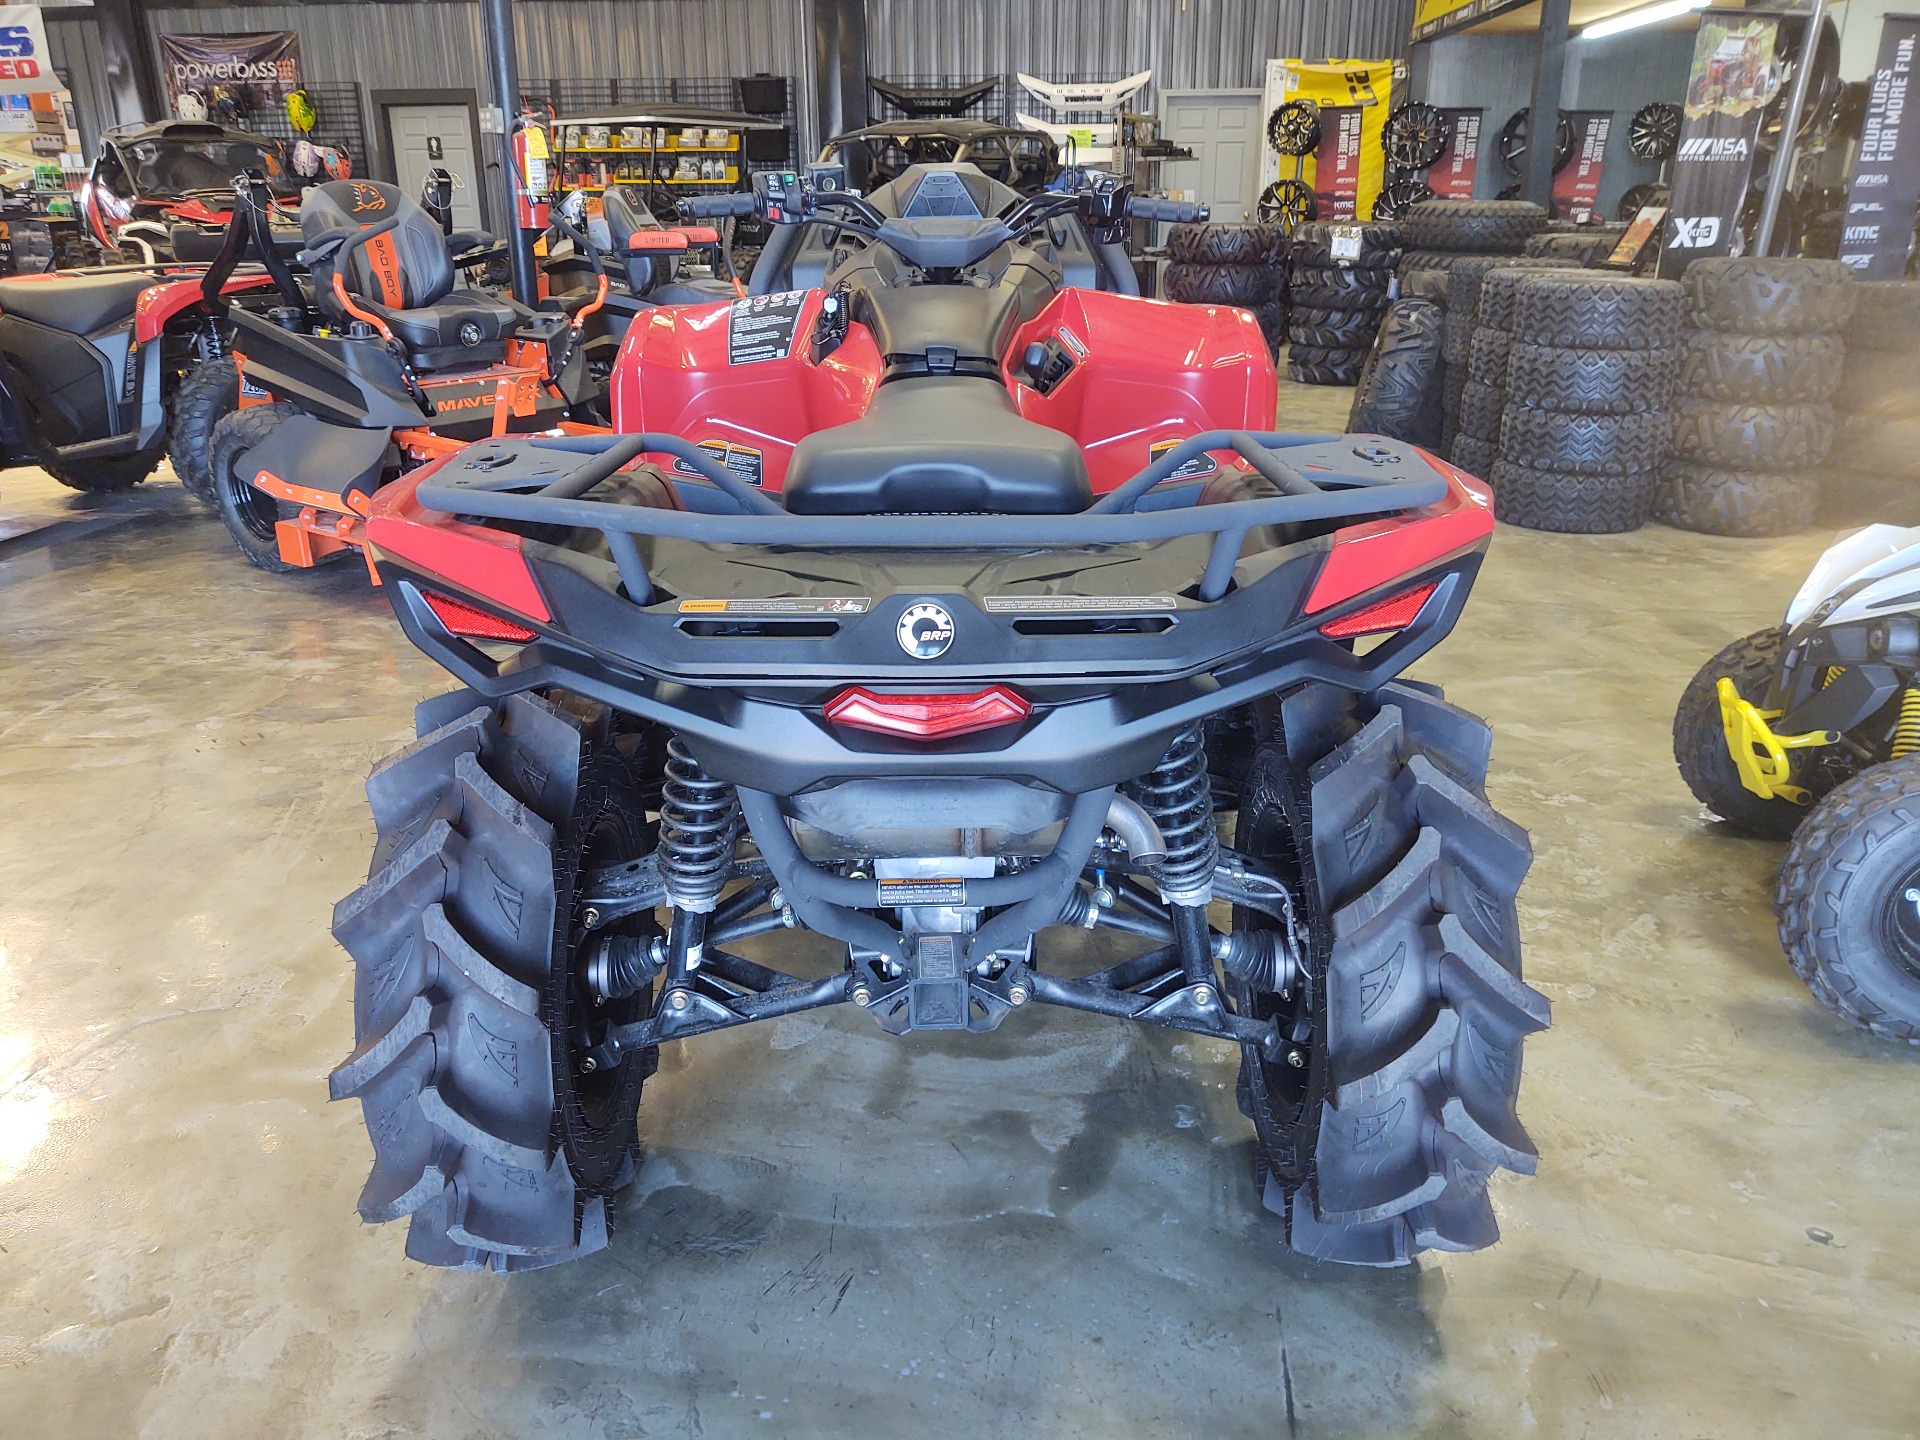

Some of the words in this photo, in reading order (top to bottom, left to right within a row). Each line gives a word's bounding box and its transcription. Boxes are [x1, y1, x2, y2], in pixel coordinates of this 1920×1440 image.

[1894, 33, 1917, 72] FUN.
[174, 56, 278, 86] powerbass
[1869, 69, 1892, 114] LUGS
[1884, 77, 1908, 124] MORE
[1339, 114, 1350, 131] FOR
[1350, 113, 1361, 135] FOUR
[1457, 116, 1469, 133] FOR
[1467, 116, 1480, 138] FOUR
[1587, 118, 1599, 135] FOR
[1596, 118, 1611, 140] FOUR
[1337, 131, 1349, 154] MORE
[1348, 135, 1360, 157] LUGS
[1453, 133, 1466, 156] MORE
[1464, 138, 1478, 160] LUGS
[1582, 136, 1596, 159] MORE
[1711, 138, 1748, 155] MSA
[1860, 117, 1882, 162] FOUR
[1877, 129, 1899, 162] FOR
[1592, 141, 1605, 163] LUGS
[1333, 201, 1355, 210] KMC
[1844, 225, 1880, 240] KMC
[375, 239, 389, 266] BAD
[383, 270, 398, 297] BOY
[610, 281, 626, 289] BAD
[920, 630, 951, 641] BRP
